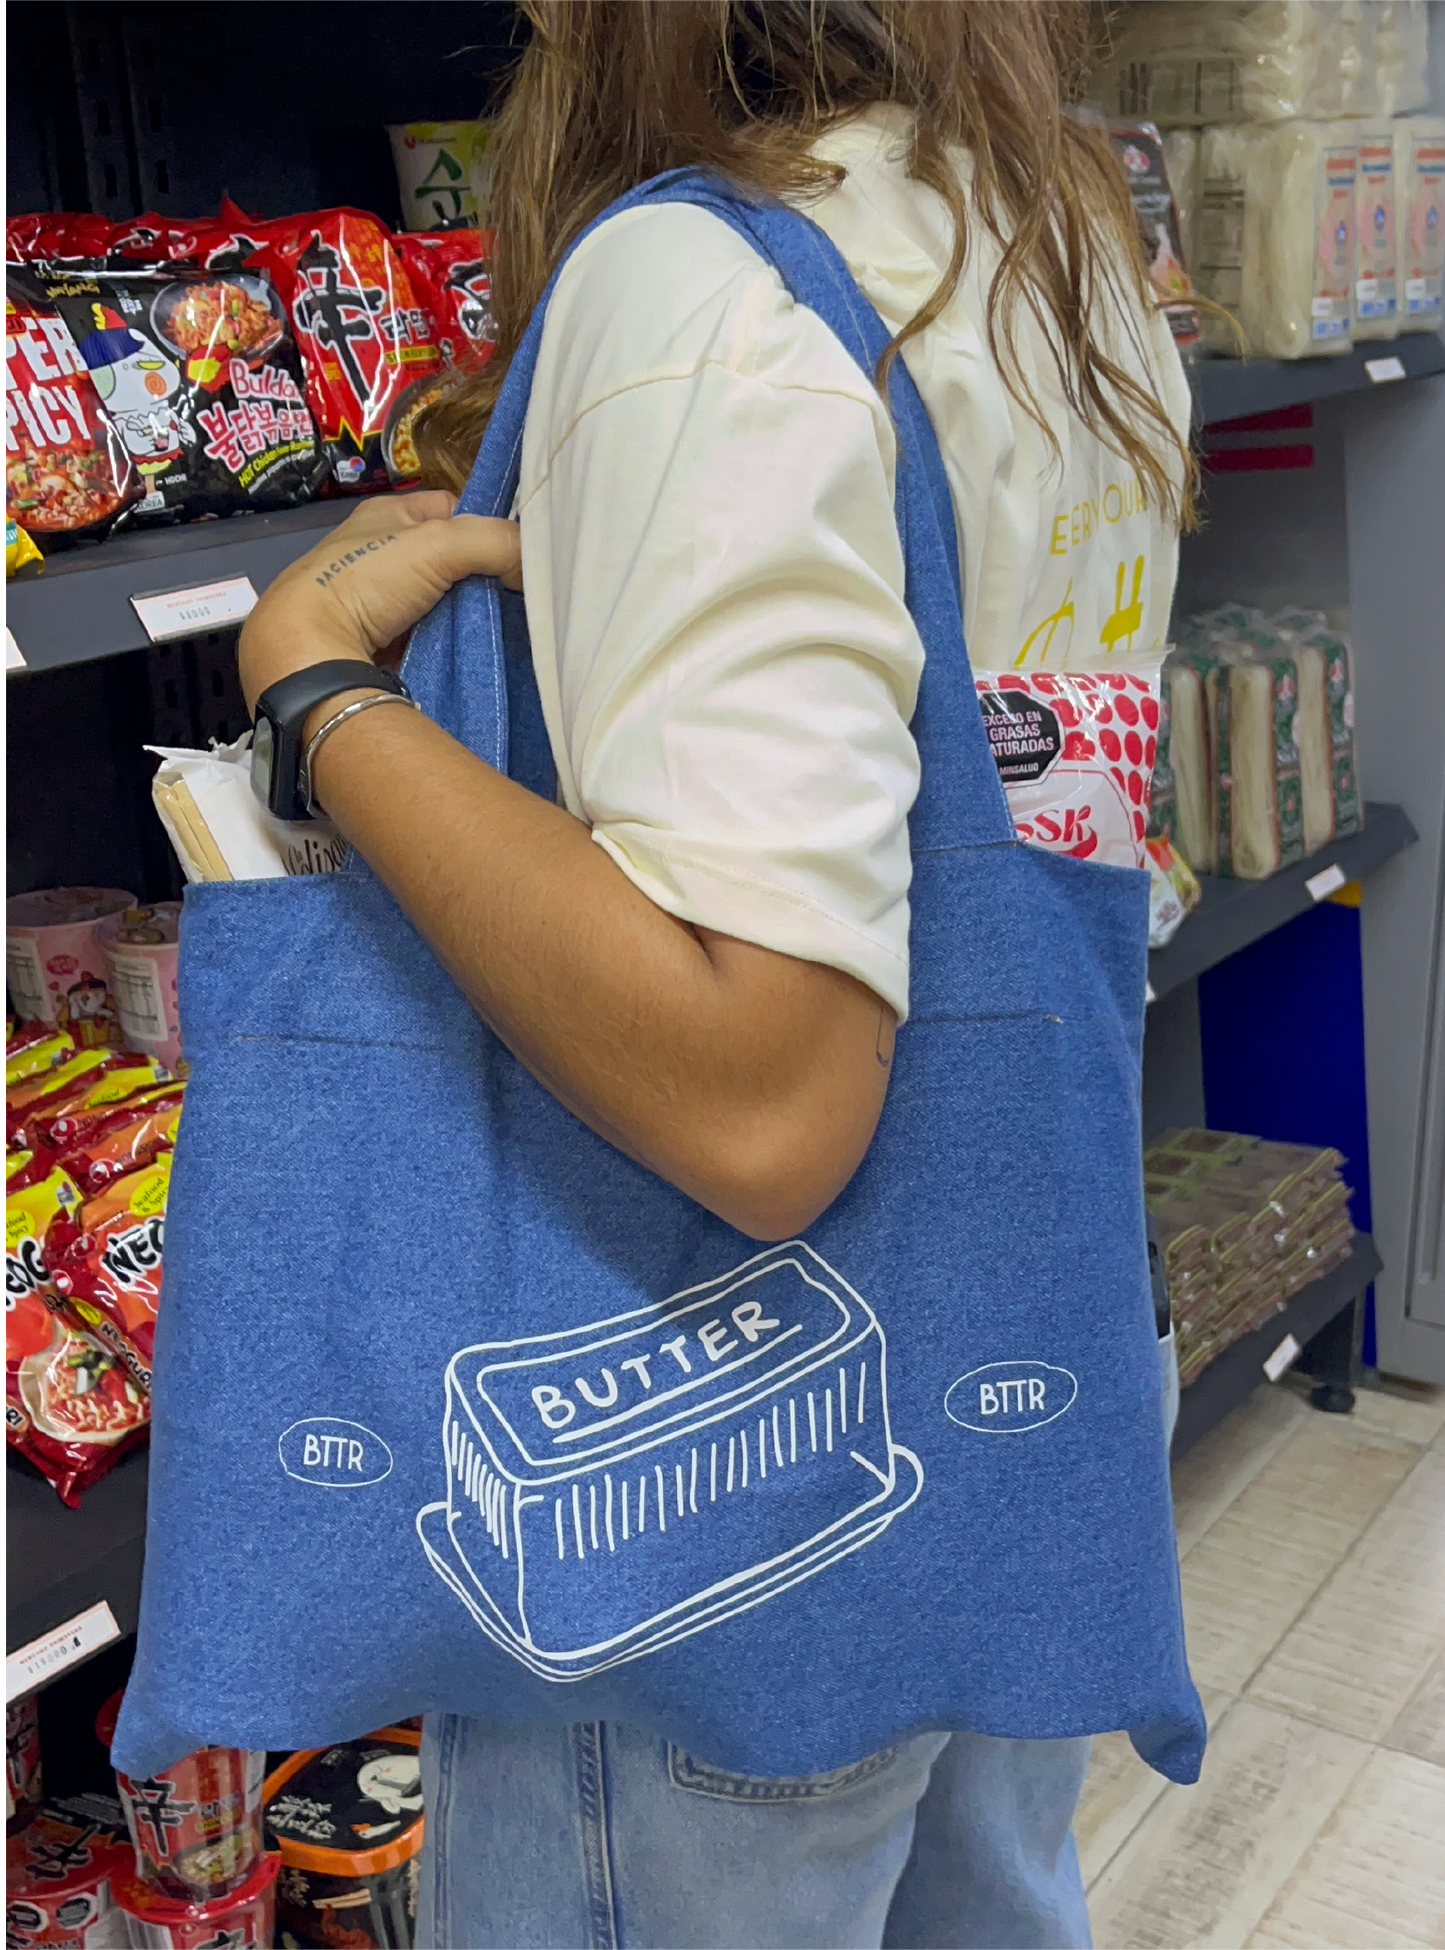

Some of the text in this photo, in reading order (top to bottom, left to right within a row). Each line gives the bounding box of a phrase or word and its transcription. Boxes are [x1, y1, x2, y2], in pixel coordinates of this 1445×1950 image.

[229, 358, 305, 404] Bulda
[315, 534, 397, 589] PACIENCIA
[983, 710, 1042, 727] EXCESO EN
[990, 723, 1041, 742] GRASAS
[532, 1300, 780, 1428] BUTTER
[980, 1380, 1046, 1416] BTTR
[303, 1437, 365, 1473] BTTR
